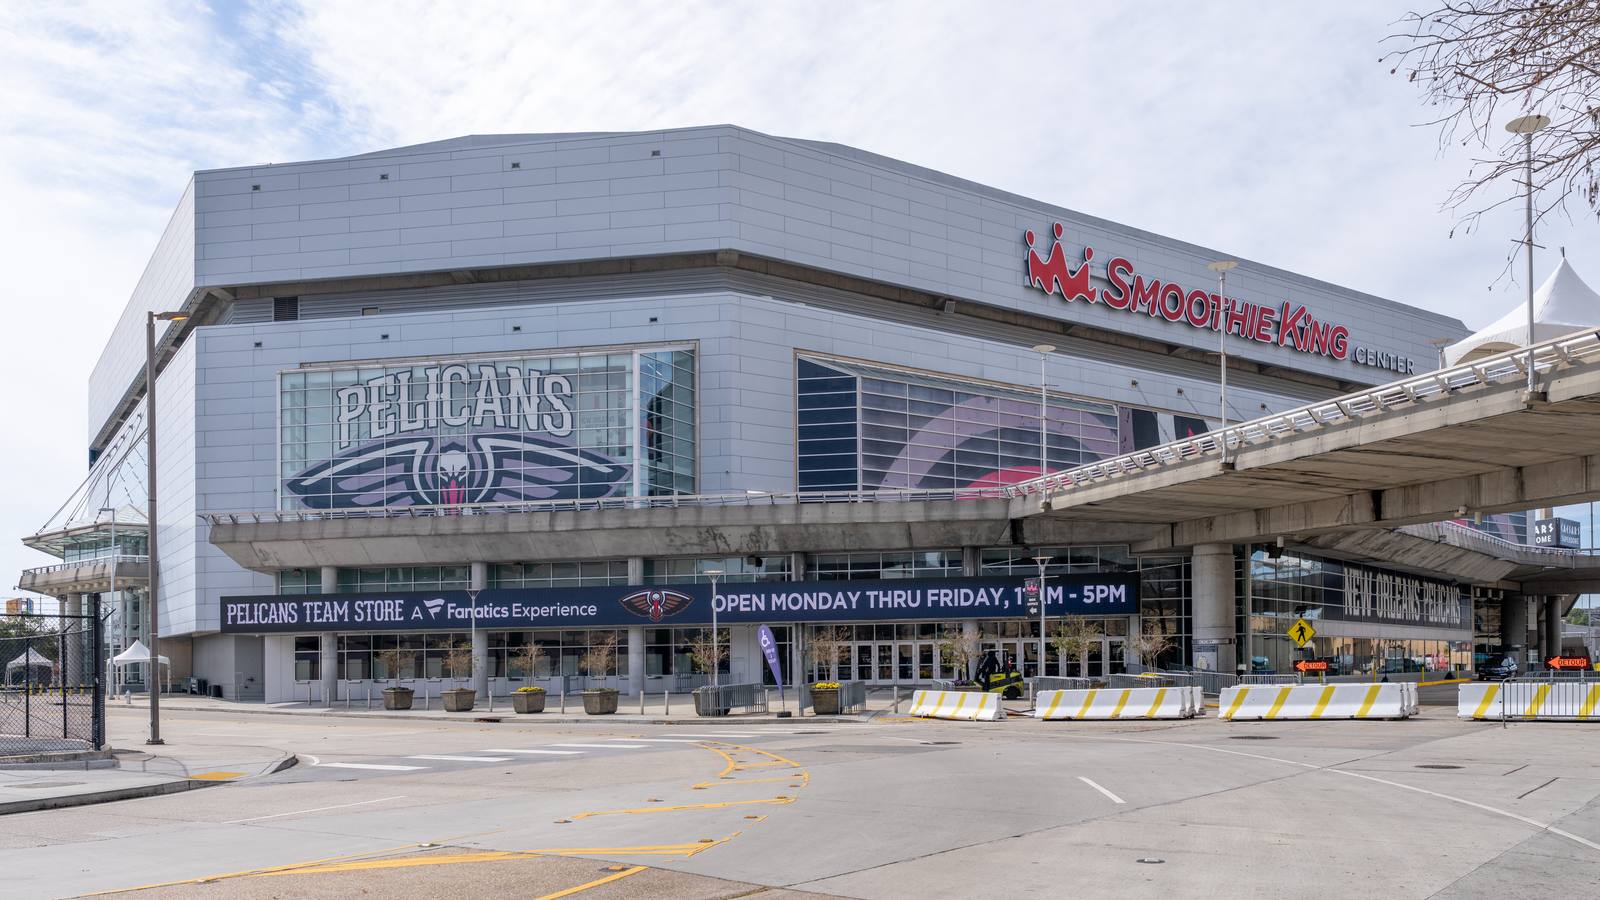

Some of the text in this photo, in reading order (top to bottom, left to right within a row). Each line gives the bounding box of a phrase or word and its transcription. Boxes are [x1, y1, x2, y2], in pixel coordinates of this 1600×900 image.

[1354, 346, 1416, 375] CENTER
[337, 364, 574, 450] PELICANS
[711, 594, 766, 612] OPEN
[771, 591, 861, 611] MONDAY
[866, 589, 921, 609] THRU
[927, 587, 1009, 609] FRIDAY,
[1083, 585, 1126, 604] 5PM
[1344, 567, 1461, 625] NEW ORLEANS PELICANS
[226, 600, 597, 625] PELICANS TEAM STORE A Fanatics Experience
